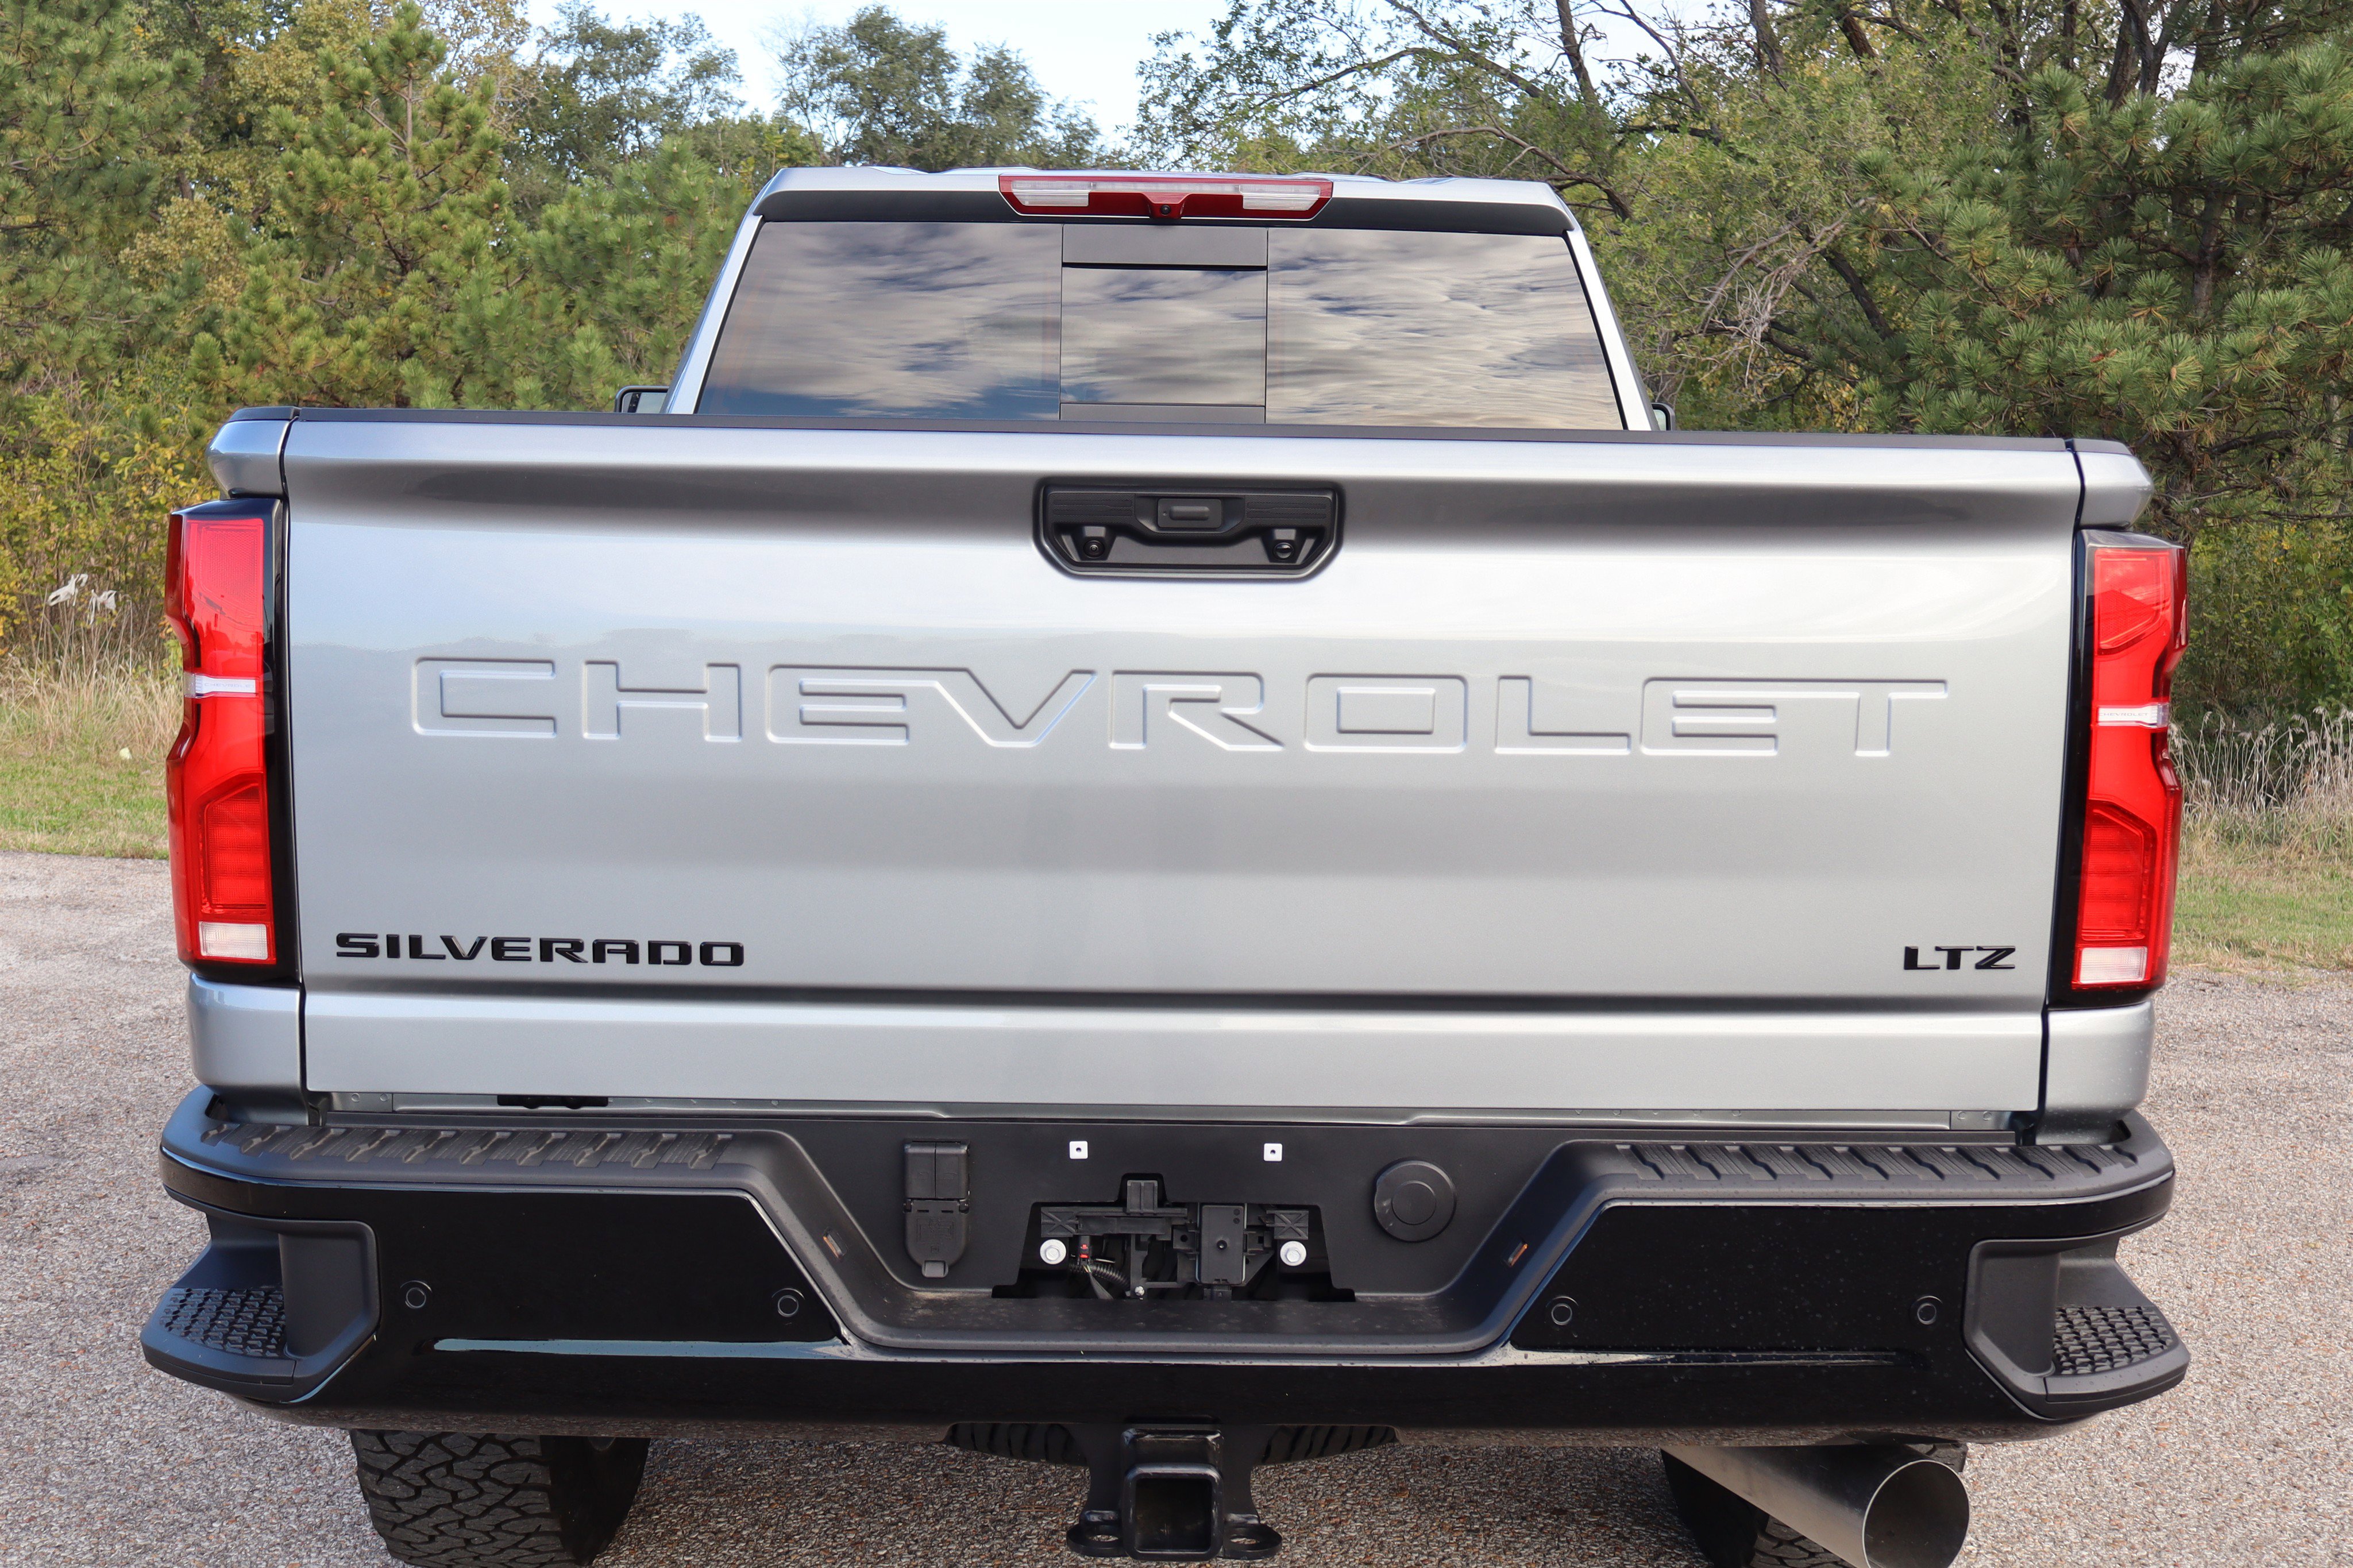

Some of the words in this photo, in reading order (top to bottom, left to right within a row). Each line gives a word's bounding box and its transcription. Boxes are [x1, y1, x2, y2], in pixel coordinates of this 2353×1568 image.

[412, 657, 1948, 757] CHEVROLET
[336, 932, 745, 967] SILVERADO
[1903, 945, 2016, 971] LTZ
